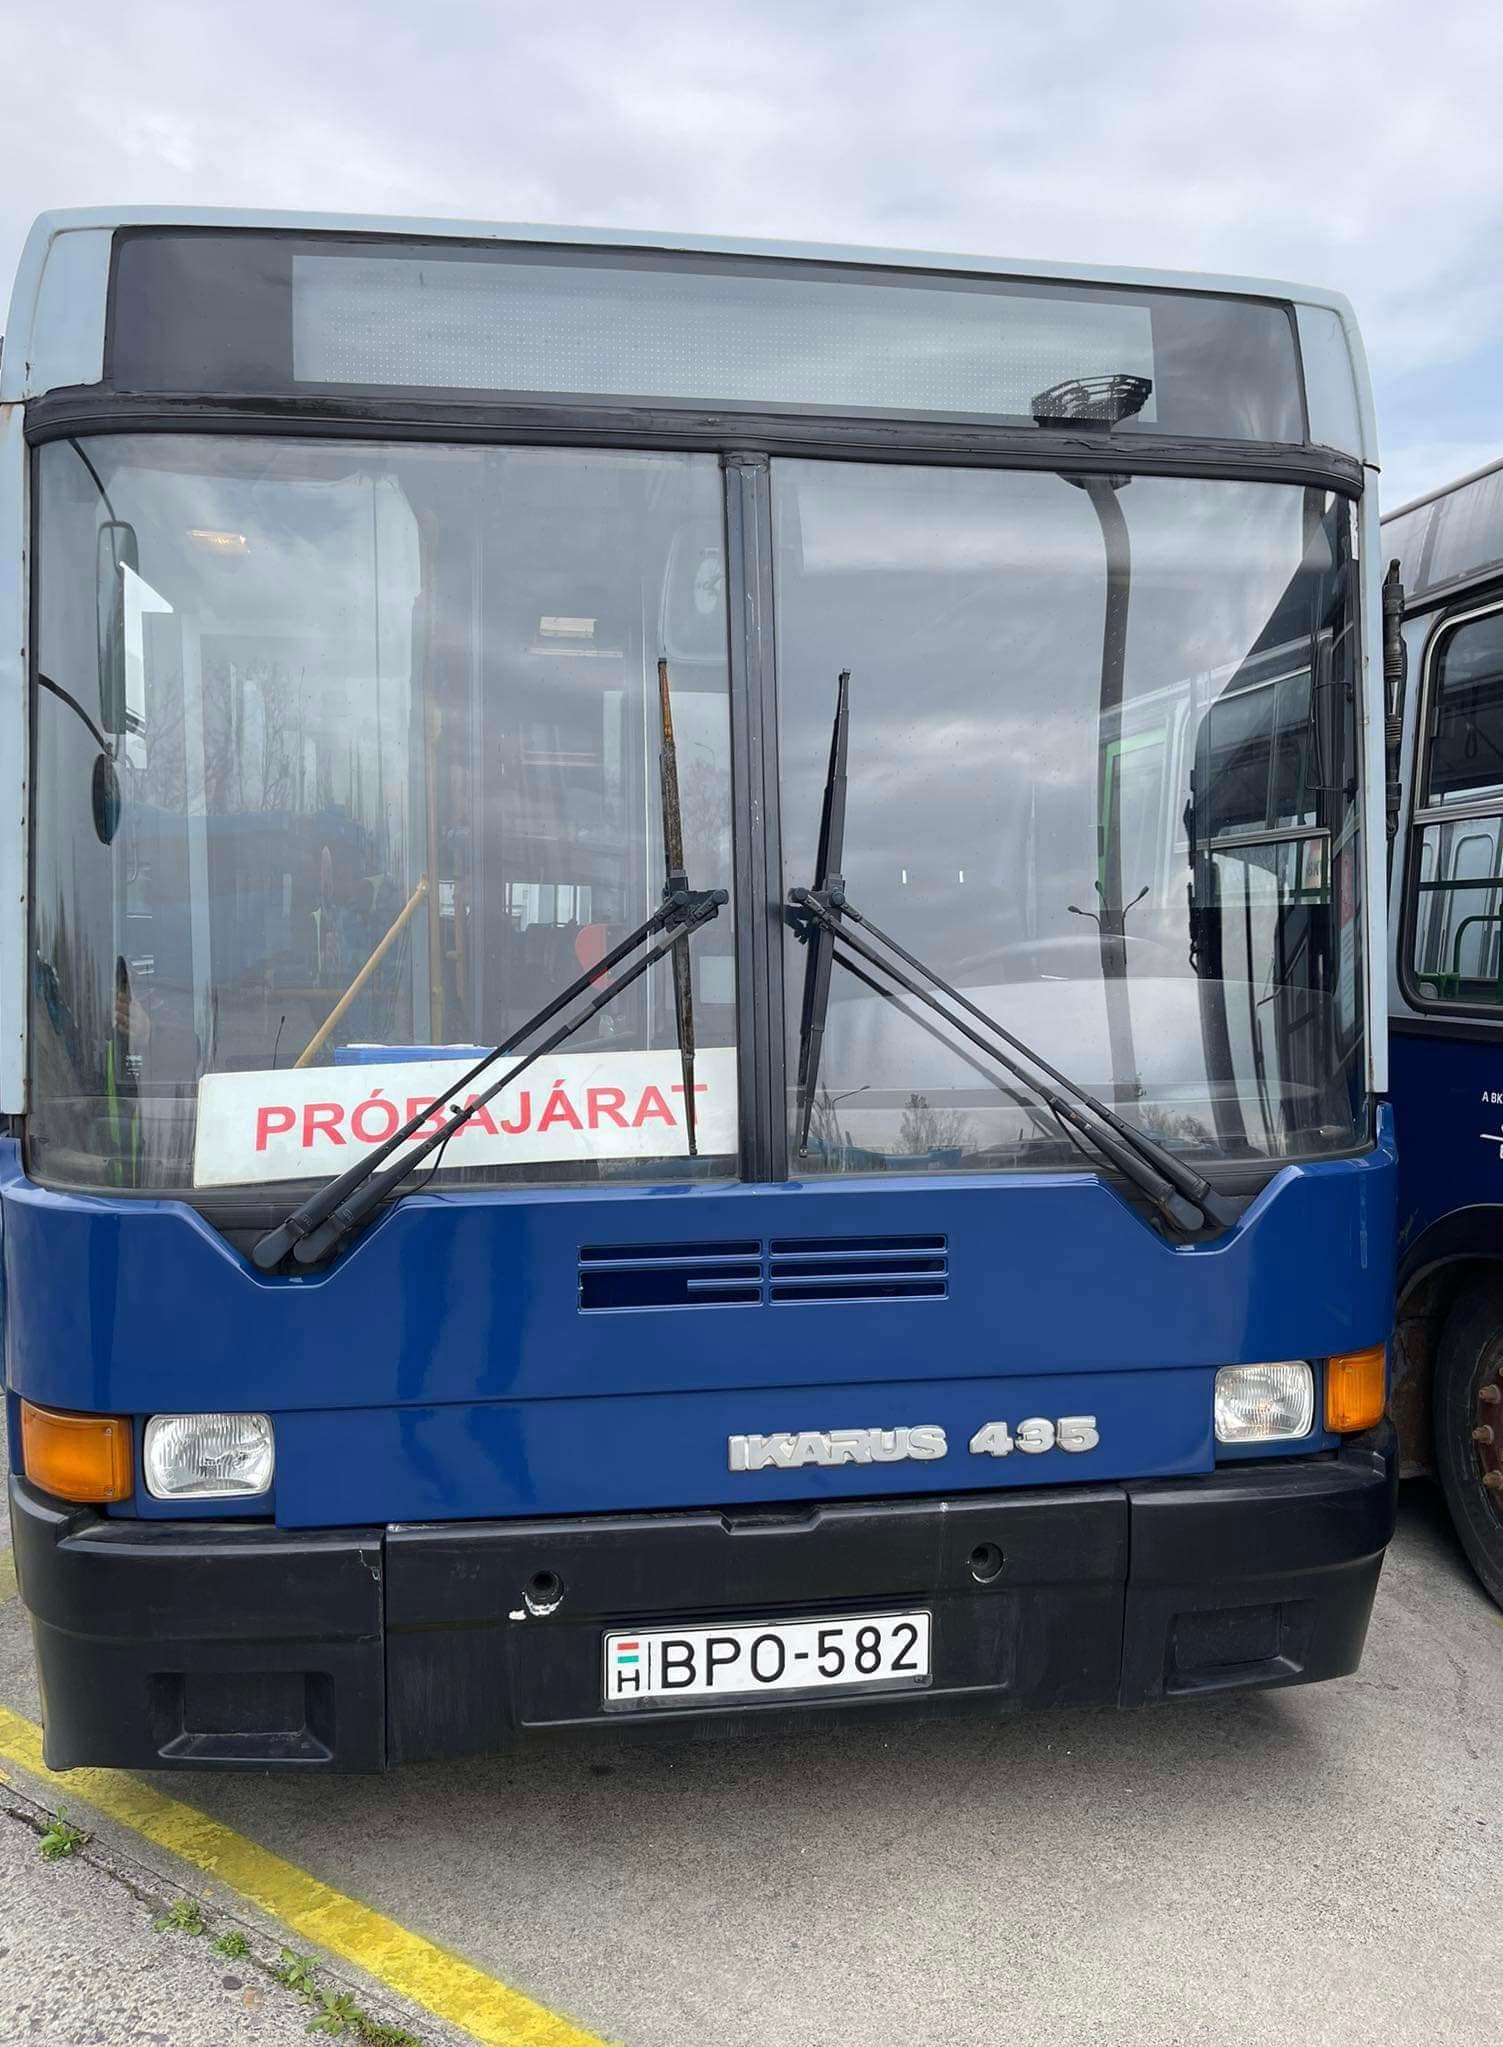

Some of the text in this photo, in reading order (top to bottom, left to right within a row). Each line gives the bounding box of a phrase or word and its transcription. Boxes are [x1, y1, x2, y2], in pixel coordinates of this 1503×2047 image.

[1481, 1091, 1489, 1103] A
[729, 1416, 1100, 1471] IKARUS 435
[617, 1623, 918, 1693] H BPO-582
